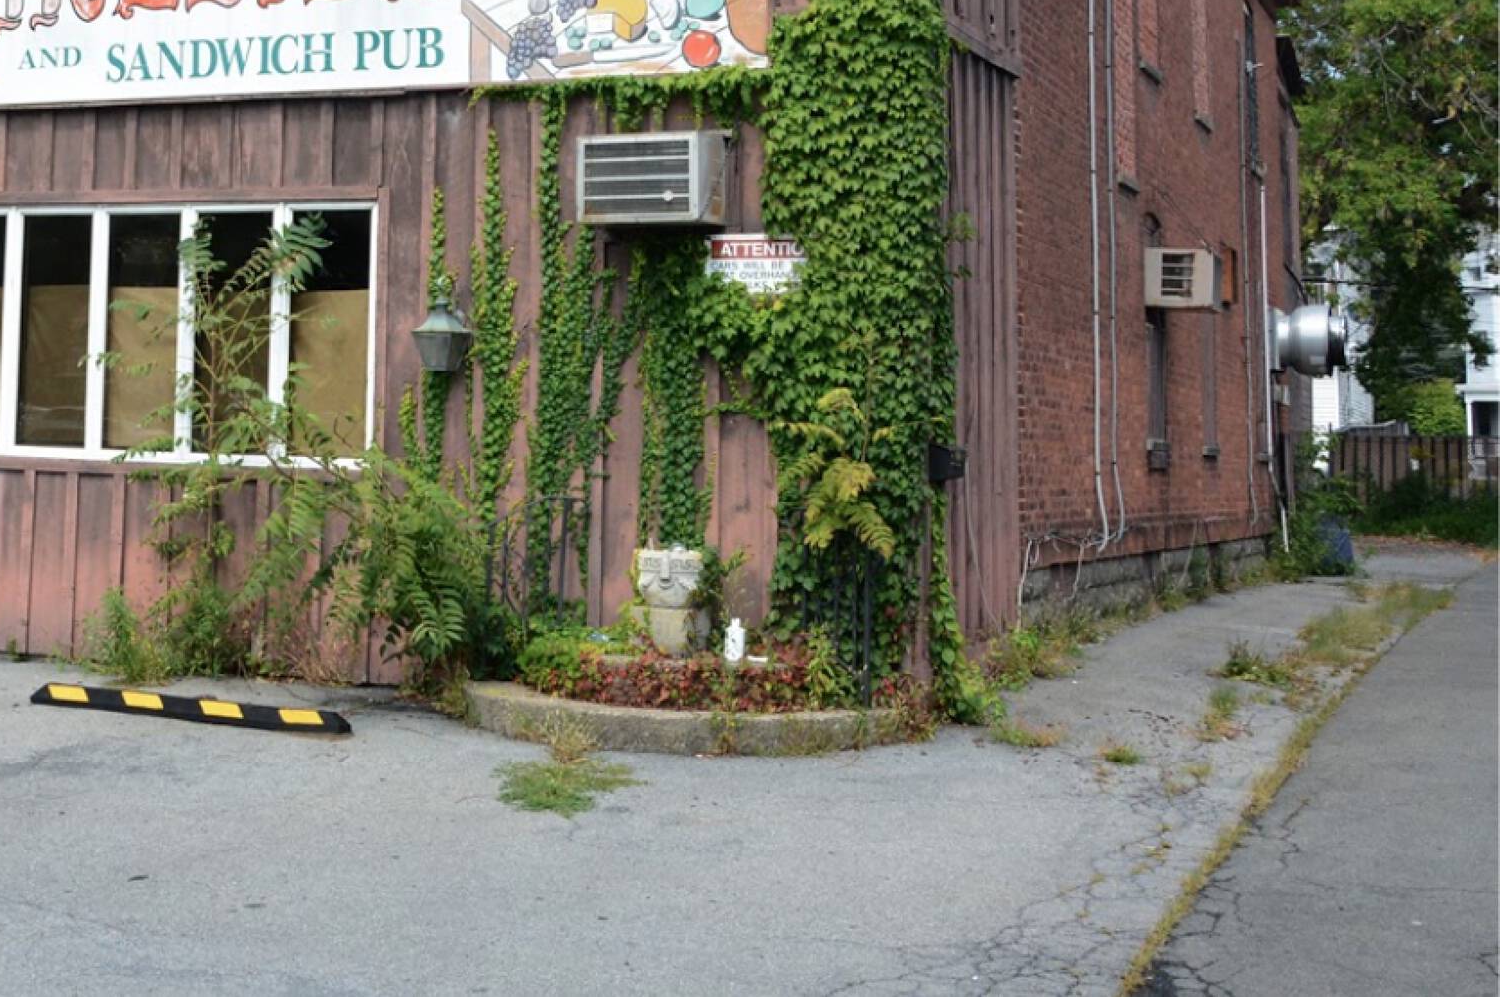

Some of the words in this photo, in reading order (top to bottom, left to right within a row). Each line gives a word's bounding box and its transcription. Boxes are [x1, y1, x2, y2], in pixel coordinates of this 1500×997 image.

[17, 46, 83, 70] AND
[106, 31, 336, 84] SANDWICH
[353, 26, 445, 72] PUB
[721, 241, 804, 256] ATTENTIO
